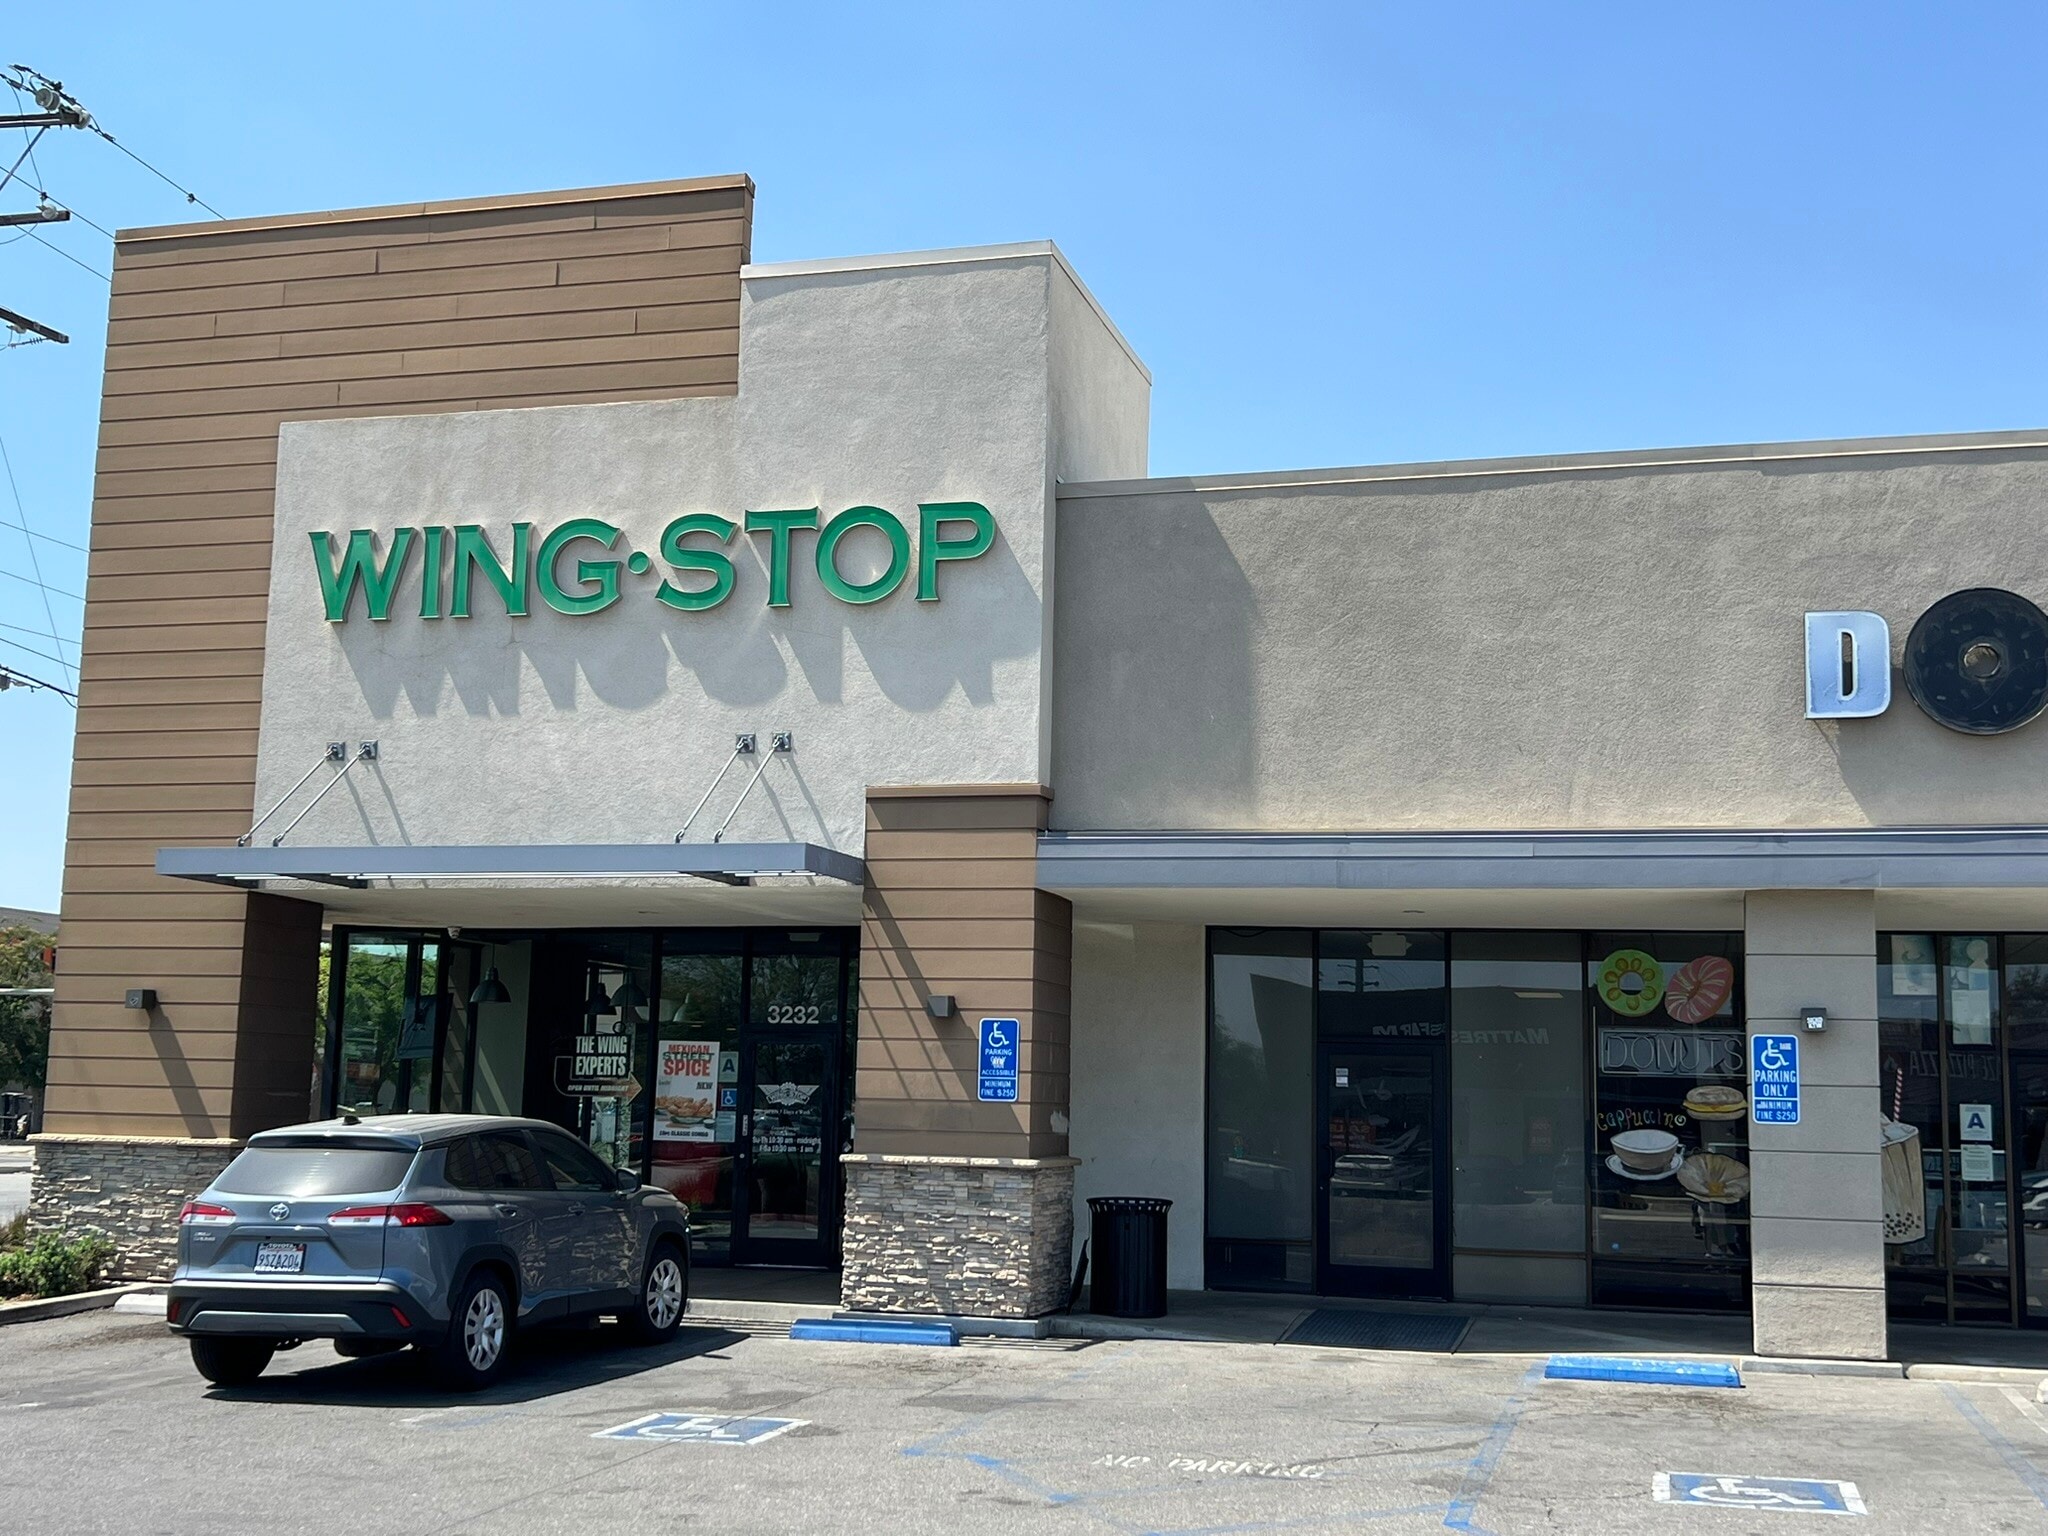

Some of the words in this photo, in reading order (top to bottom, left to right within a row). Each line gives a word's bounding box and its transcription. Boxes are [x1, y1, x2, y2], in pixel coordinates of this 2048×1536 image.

[767, 1005, 820, 1025] 3232
[576, 1035, 595, 1054] THE
[597, 1035, 628, 1054] WING
[668, 1044, 711, 1054] MEXICAN
[985, 1048, 1013, 1056] PARKING
[662, 1051, 716, 1061] STREET
[1607, 1035, 1743, 1071] DONUTS
[575, 1056, 627, 1076] EXPERTS
[663, 1059, 711, 1077] SPICE
[722, 1058, 736, 1073] A
[984, 1080, 1011, 1088] MINIMUM
[1755, 1070, 1796, 1083] PARKING
[981, 1088, 995, 1096] FINE
[997, 1089, 1015, 1097] $250
[1763, 1084, 1789, 1097] ONLY
[1757, 1111, 1773, 1120] FINE
[1776, 1111, 1797, 1121] $250
[1967, 1112, 1986, 1129] A
[258, 1253, 300, 1268] 9SZA204
[1167, 1453, 1326, 1479] PARKING
